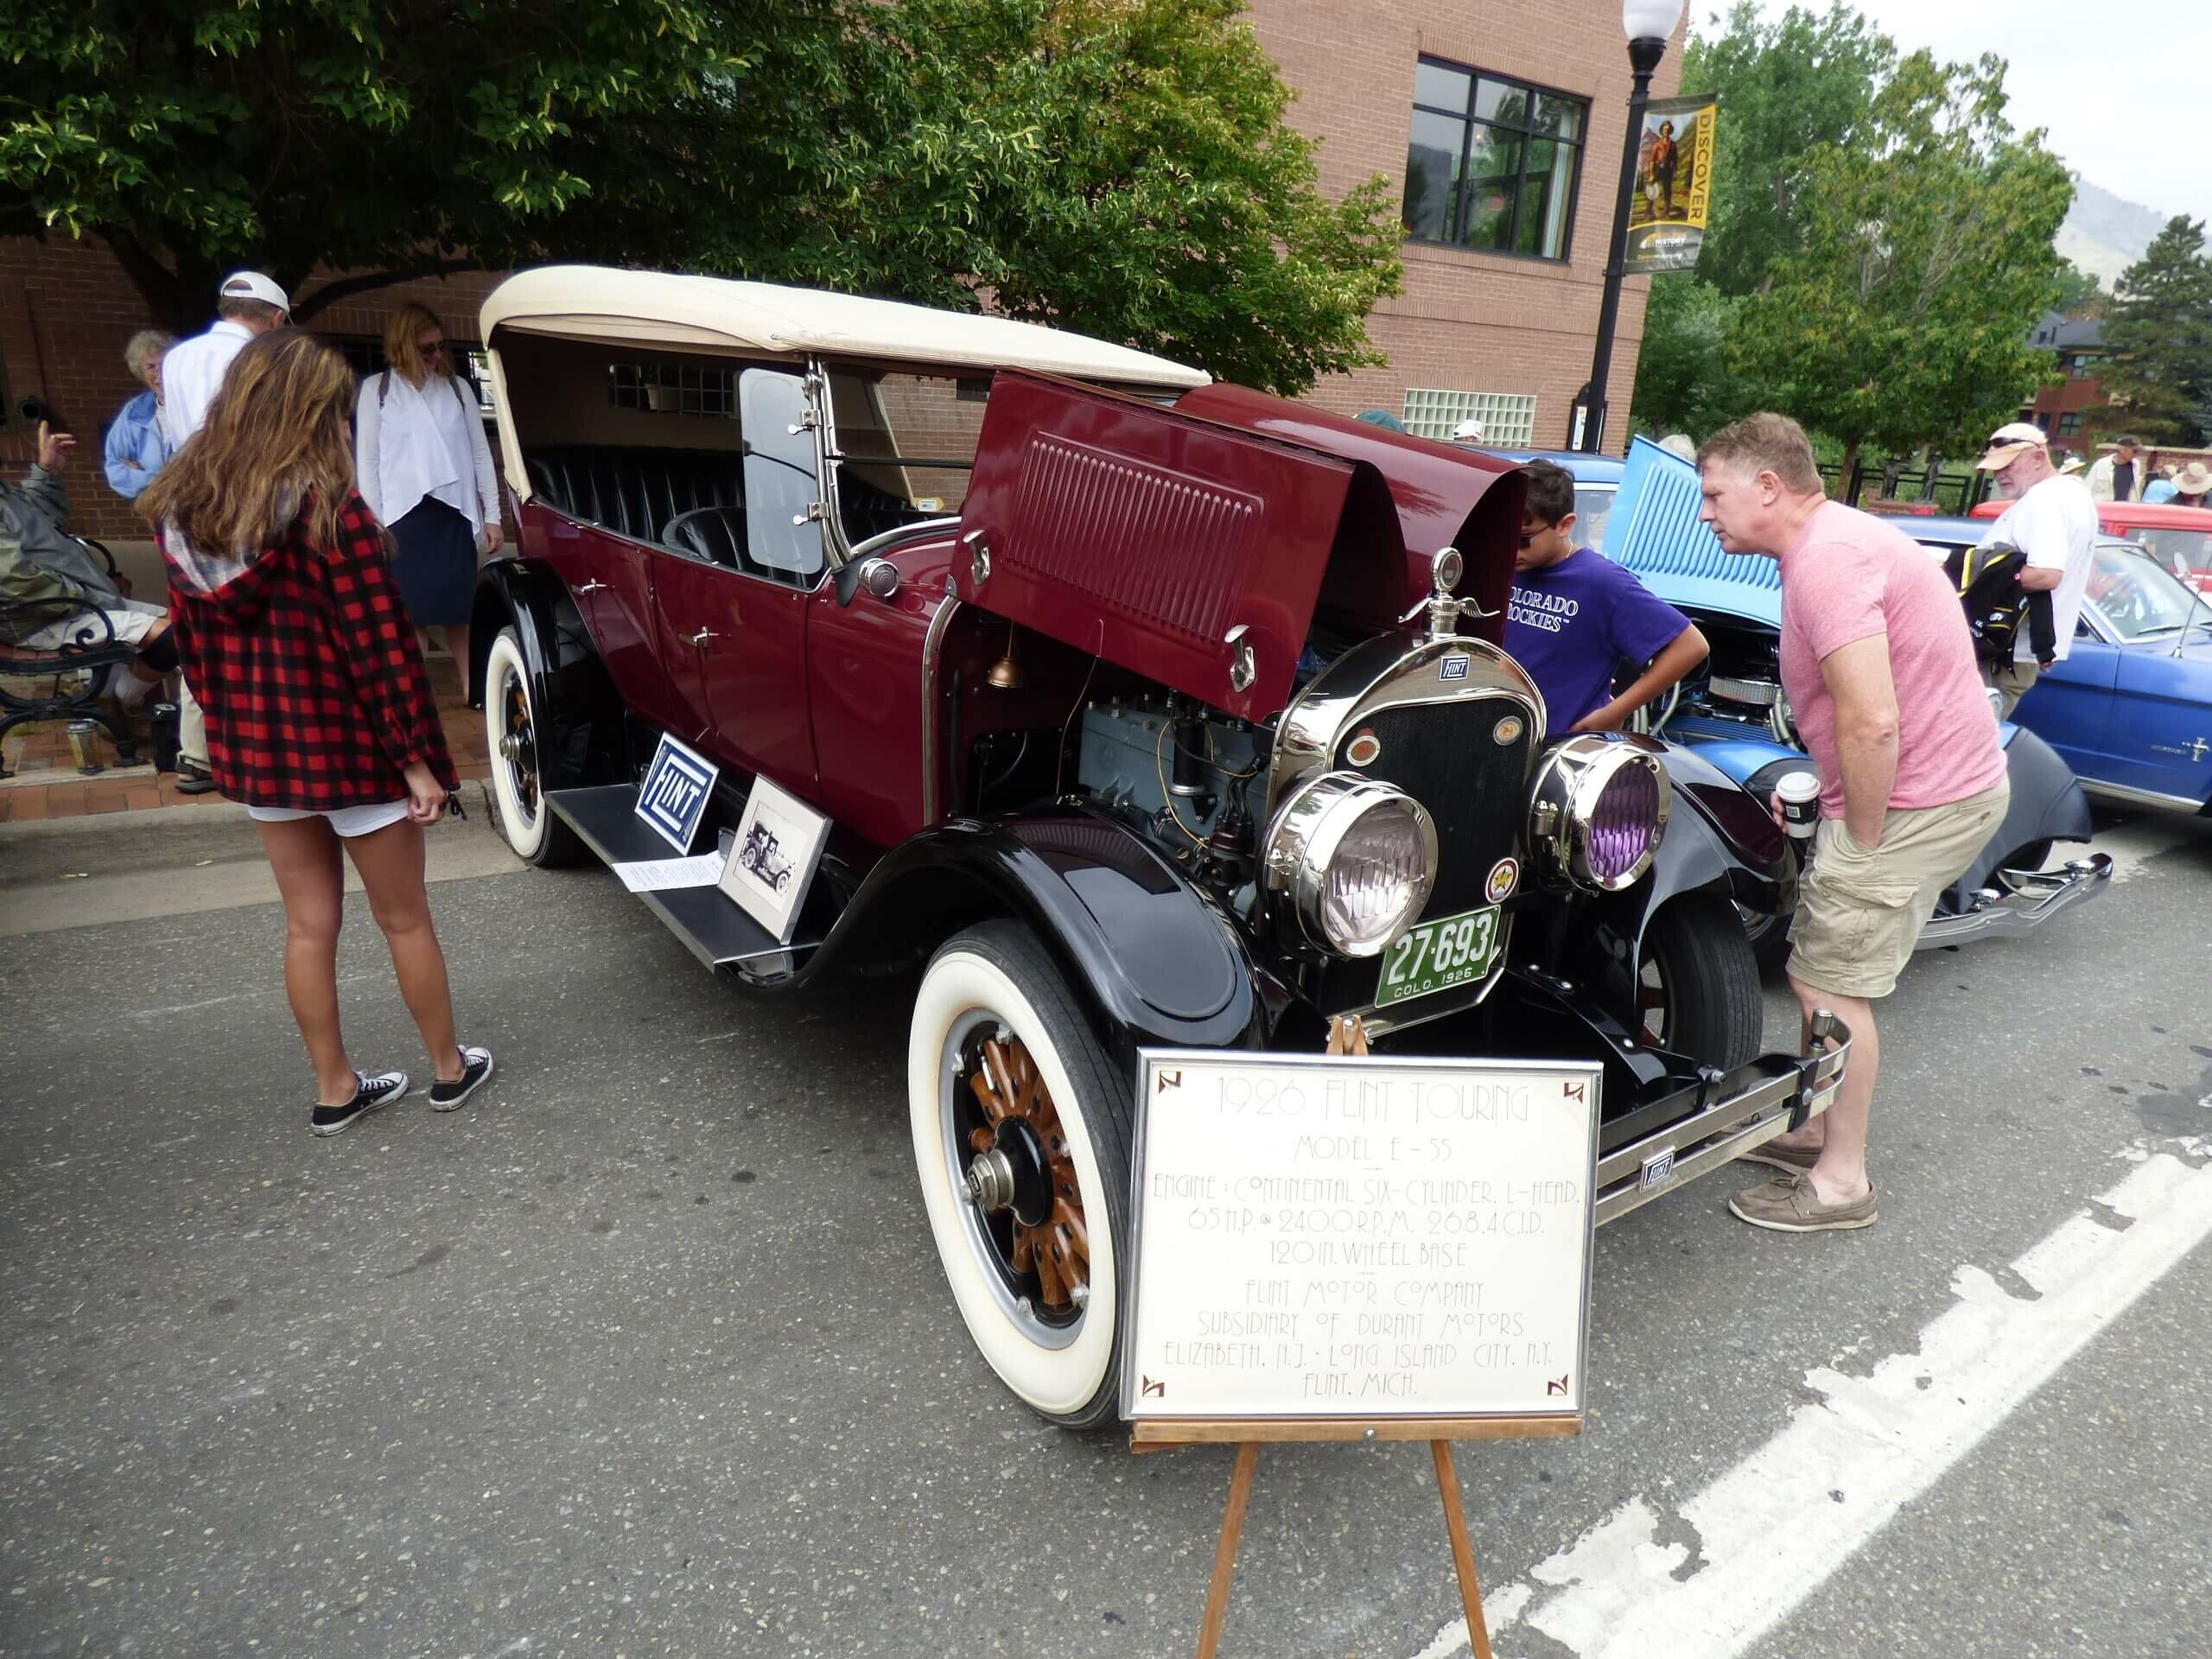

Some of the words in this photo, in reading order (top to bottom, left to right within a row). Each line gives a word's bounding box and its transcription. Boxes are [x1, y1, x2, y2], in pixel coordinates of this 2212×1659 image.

[1689, 113, 1711, 220] DISCOVER
[1510, 586, 1579, 617] OLORADO
[1443, 658, 1467, 678] FLINT
[644, 753, 708, 832] FLINT
[1441, 967, 1472, 985] 1926
[1218, 1077, 1306, 1116] 1926
[1324, 1079, 1394, 1123] FLINT
[1410, 1082, 1529, 1126] TOURING
[1294, 1135, 1372, 1161] MODEL
[1235, 1176, 1355, 1203] CONTINENTAL
[1343, 1242, 1410, 1268] WHEEL
[1420, 1243, 1466, 1270] BASE
[1245, 1280, 1292, 1306] FLINT
[1303, 1281, 1377, 1307] MOTOR
[1395, 1281, 1484, 1307] COMPANY
[1198, 1310, 1299, 1338] SUBSIDIARY
[1316, 1313, 1341, 1338] OF
[1358, 1313, 1424, 1339] DURANT
[1440, 1313, 1523, 1339] MOTORS
[1277, 1343, 1306, 1369] N.J.
[1329, 1344, 1378, 1369] LONG
[1395, 1343, 1457, 1369] ISLAND
[1527, 1342, 1553, 1368] N.Y.
[1360, 1372, 1417, 1397] MICH.
